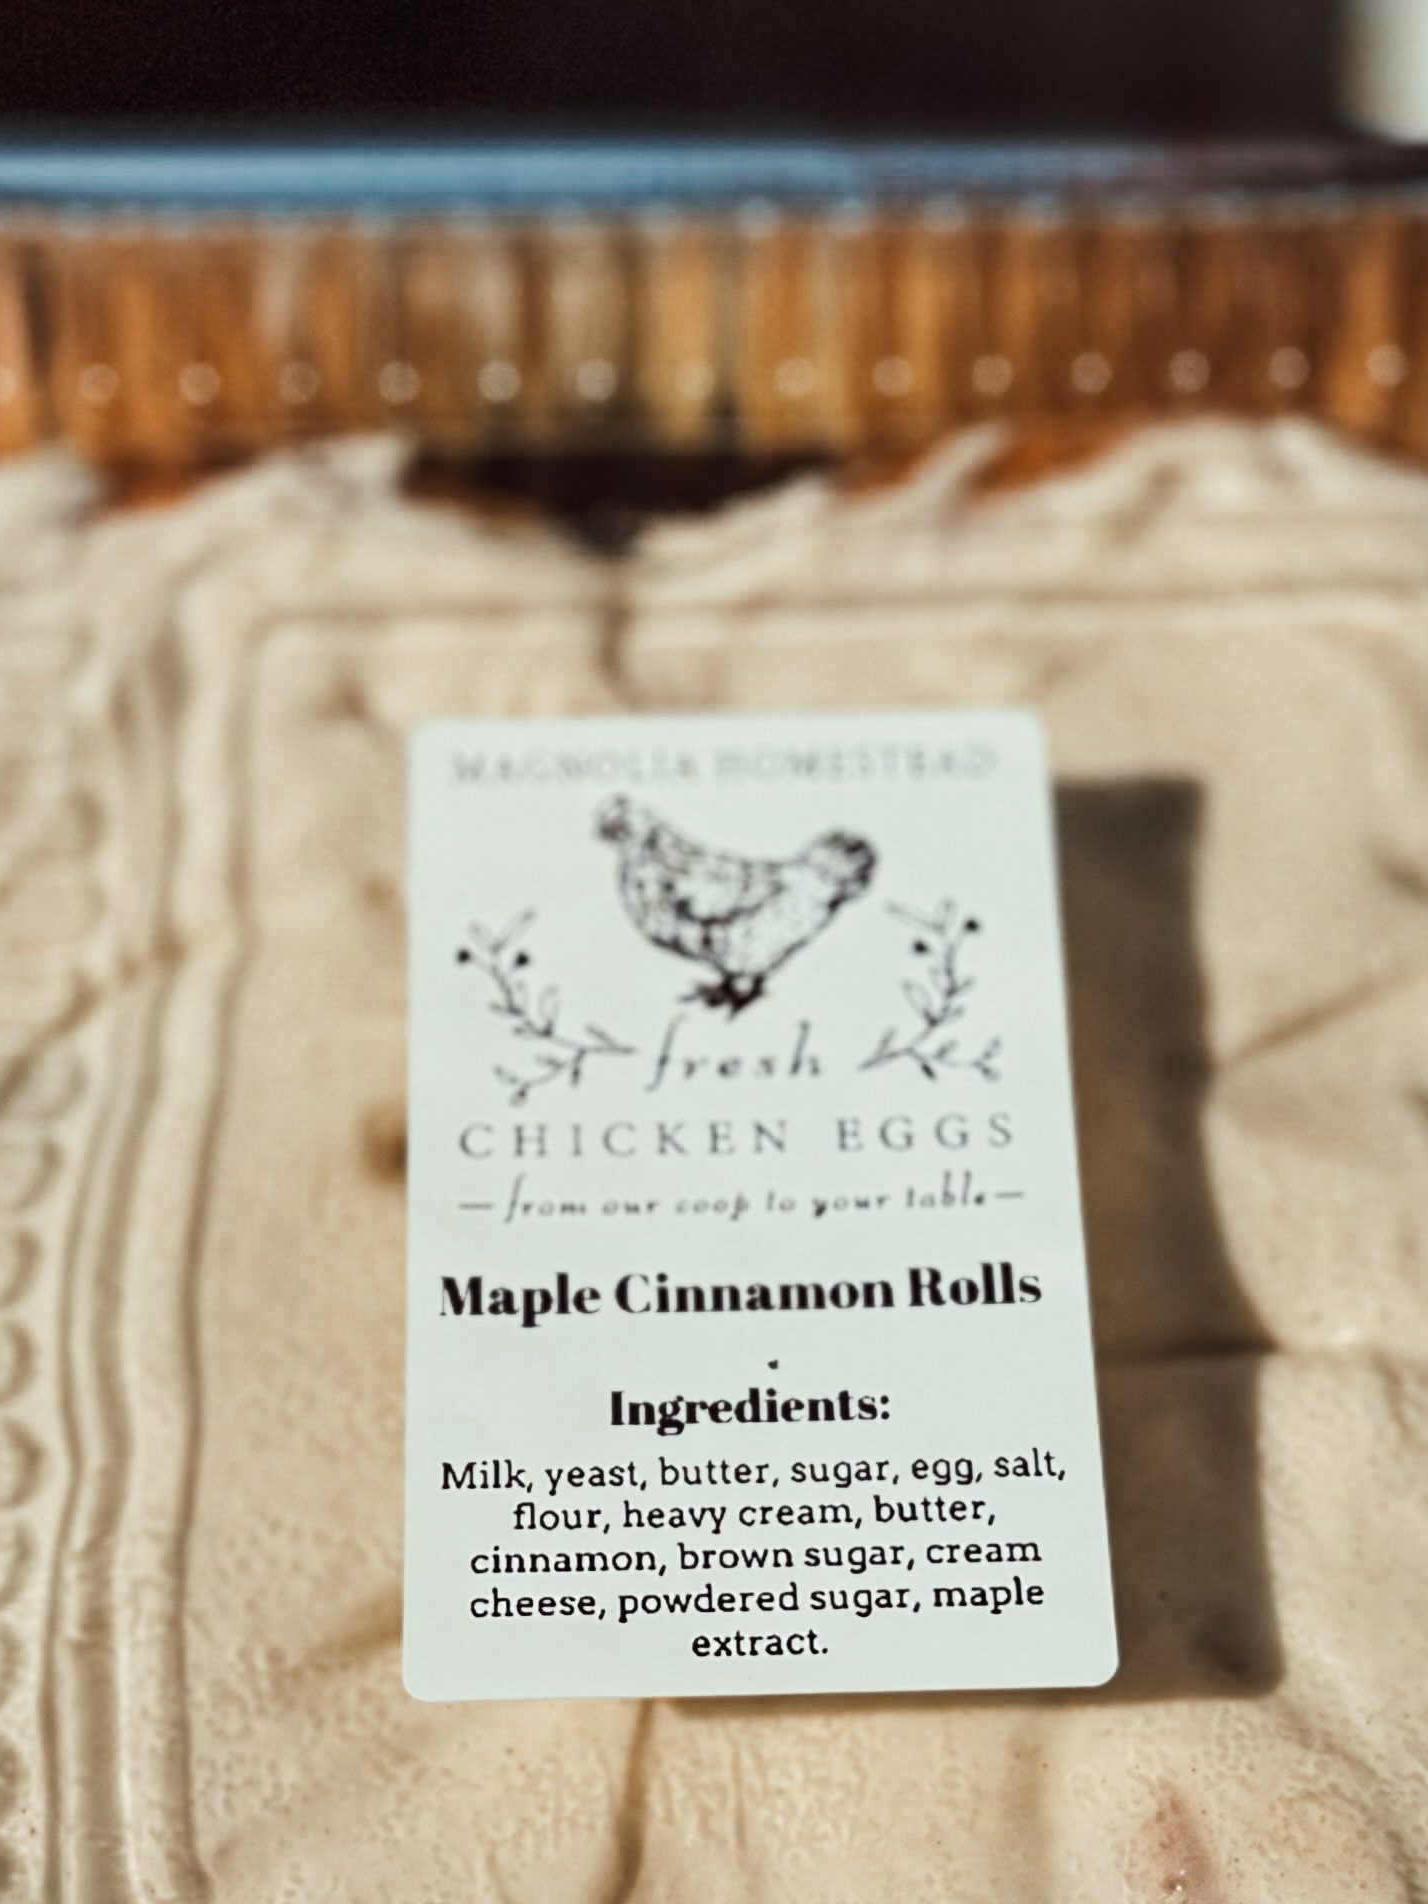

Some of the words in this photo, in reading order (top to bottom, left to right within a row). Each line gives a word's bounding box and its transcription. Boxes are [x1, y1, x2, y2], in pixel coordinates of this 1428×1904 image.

[448, 749, 701, 788] MAGNOLIA
[713, 742, 1000, 783] HOMESTEAD
[644, 1011, 823, 1093] fresh
[456, 1118, 787, 1160] CHICKEN
[835, 1112, 1014, 1154] EGGS
[502, 1172, 589, 1225] from
[600, 1199, 659, 1216] our
[673, 1192, 751, 1224] coop
[764, 1188, 798, 1214] to
[811, 1195, 888, 1220] your
[904, 1168, 988, 1210] table
[439, 1270, 603, 1330] Maple
[613, 1271, 896, 1315] Cinnamon
[907, 1260, 1043, 1309] Rolls
[609, 1386, 891, 1438] Ingredients:
[440, 1457, 535, 1495] Milk,
[543, 1460, 648, 1498] yeast,
[657, 1454, 780, 1489] butter,
[789, 1458, 901, 1490] sugar,
[910, 1456, 984, 1488] egg,
[992, 1445, 1067, 1483] salt,
[512, 1500, 612, 1536] flour,
[621, 1498, 728, 1536] heavy
[737, 1502, 864, 1531] cream,
[871, 1493, 997, 1528] butter,
[469, 1544, 668, 1578] cinnamon,
[675, 1540, 795, 1571] brown
[802, 1544, 916, 1576] sugar,
[925, 1540, 1044, 1566] cream
[469, 1585, 607, 1622] cheese,
[616, 1580, 801, 1625] powdered
[809, 1587, 922, 1619] sugar,
[931, 1575, 1046, 1616] maple
[690, 1628, 830, 1659] extract.
